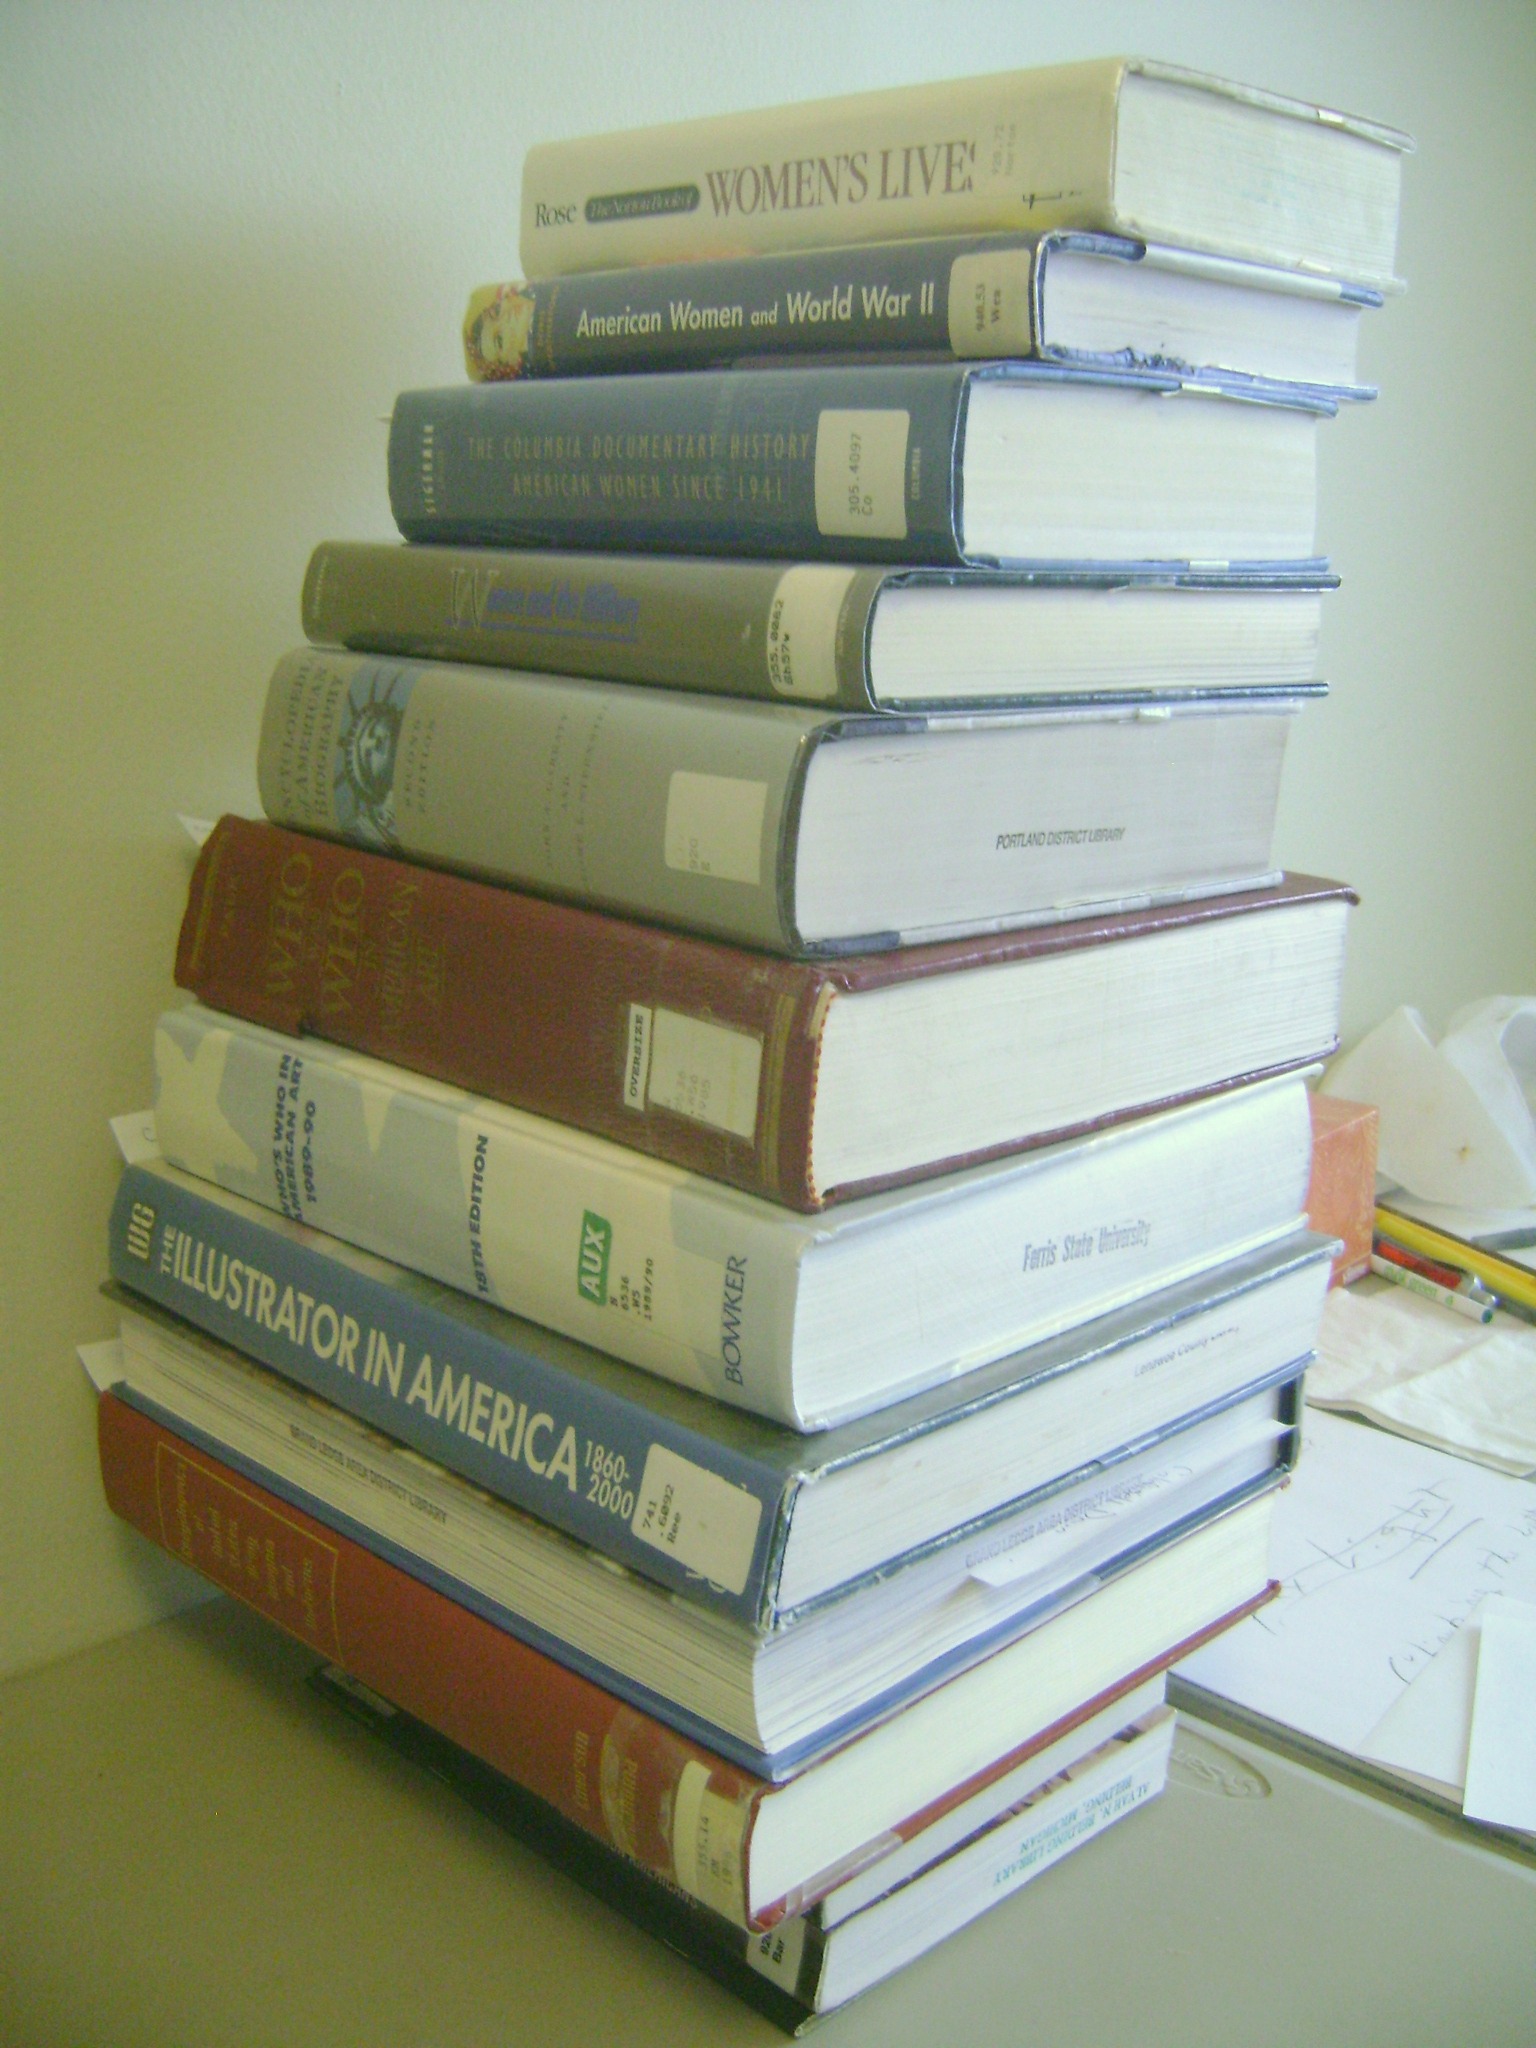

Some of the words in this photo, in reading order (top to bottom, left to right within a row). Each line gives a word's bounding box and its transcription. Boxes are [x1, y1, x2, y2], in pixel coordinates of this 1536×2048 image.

[535, 202, 577, 229] Rose
[706, 153, 868, 218] WOMEN'S
[577, 309, 662, 339] American
[669, 301, 743, 331] Women
[751, 303, 778, 326] and
[787, 286, 853, 325] World
[861, 286, 912, 319] War
[919, 282, 934, 315] II
[468, 437, 494, 461] THE
[503, 436, 581, 460] COLUMBIA
[592, 434, 719, 460] DOCUMENTARY
[730, 433, 811, 459] HISTORY
[512, 473, 590, 497] AMERICAN
[598, 475, 660, 499] WOMEN
[672, 474, 723, 501] SINCE
[738, 476, 783, 502] 1941
[847, 432, 862, 515] 305.4097
[861, 494, 874, 517] Co
[995, 830, 1046, 851] PORTLAND
[1046, 829, 1088, 846] DISTRICT
[1088, 826, 1127, 843] LIBRARY
[277, 1053, 292, 1080] IN
[289, 1058, 304, 1101] ART
[629, 1015, 645, 1097] OVERSIZE
[273, 1086, 287, 1141] WHO
[303, 1101, 317, 1202] 1989-90
[469, 1134, 489, 1230] EDITION
[472, 1233, 490, 1294] 18TH
[579, 1224, 606, 1298] AUX
[1023, 1238, 1056, 1272] Ferris
[1063, 1233, 1093, 1262] State
[1099, 1220, 1150, 1254] University
[723, 1255, 748, 1386] BOWKER
[162, 1224, 177, 1274] THE
[173, 1228, 360, 1374] ILLUSTRATOR
[363, 1329, 405, 1399] IN
[406, 1354, 580, 1493] AMERICA
[583, 1440, 629, 1487] 1860-
[585, 1475, 634, 1520] 2000
[642, 1499, 657, 1529] 741
[657, 1484, 675, 1537] .6092
[666, 1512, 682, 1544] Ree
[771, 1937, 786, 1964] Bar
